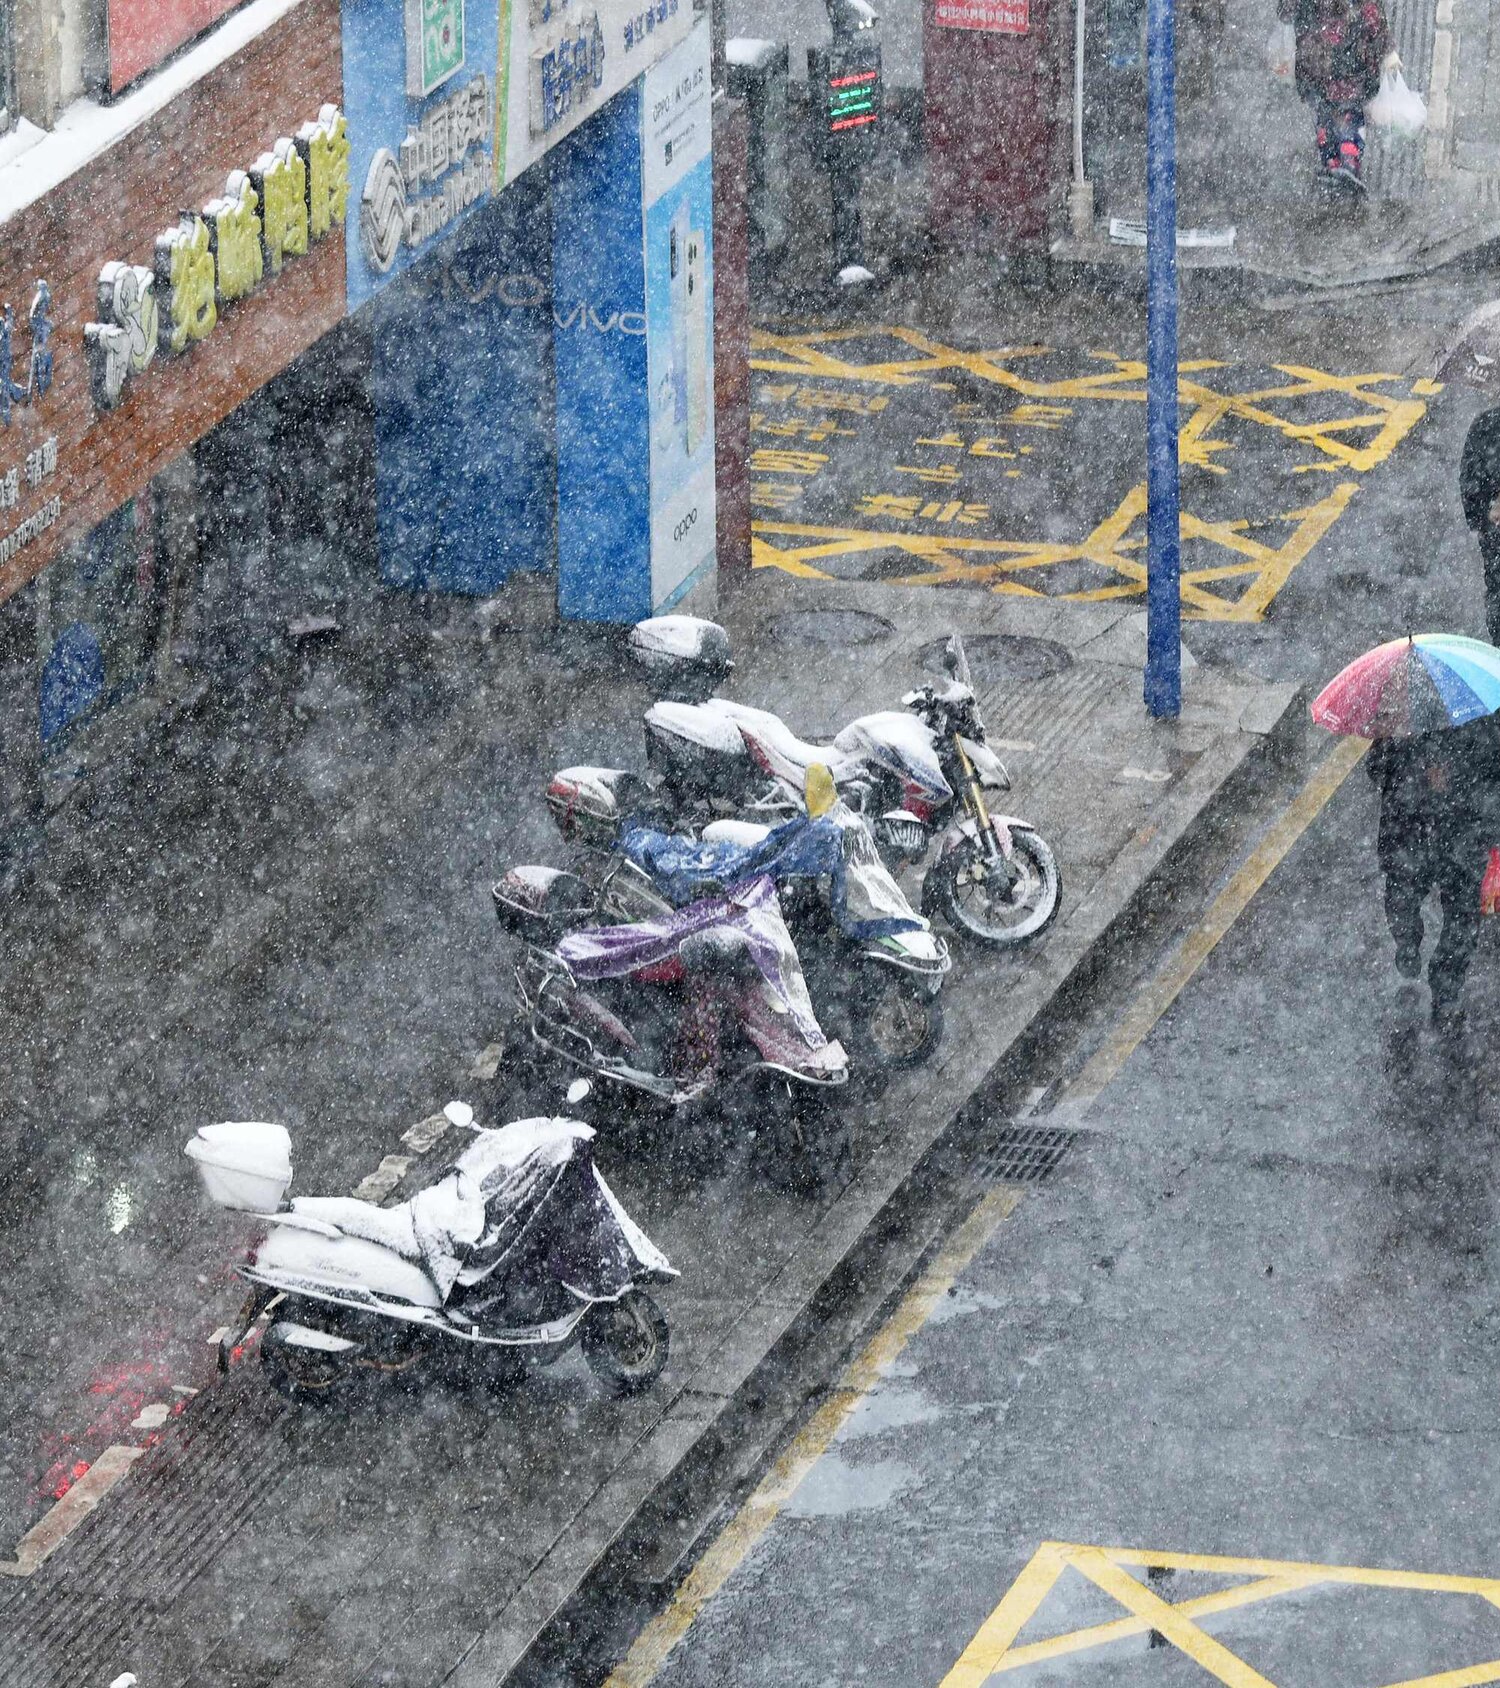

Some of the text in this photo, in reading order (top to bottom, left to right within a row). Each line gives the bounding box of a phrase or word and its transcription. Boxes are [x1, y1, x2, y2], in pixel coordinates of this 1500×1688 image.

[402, 73, 495, 195] 中国移动
[552, 300, 648, 335] vivo
[673, 507, 698, 542] oppo
